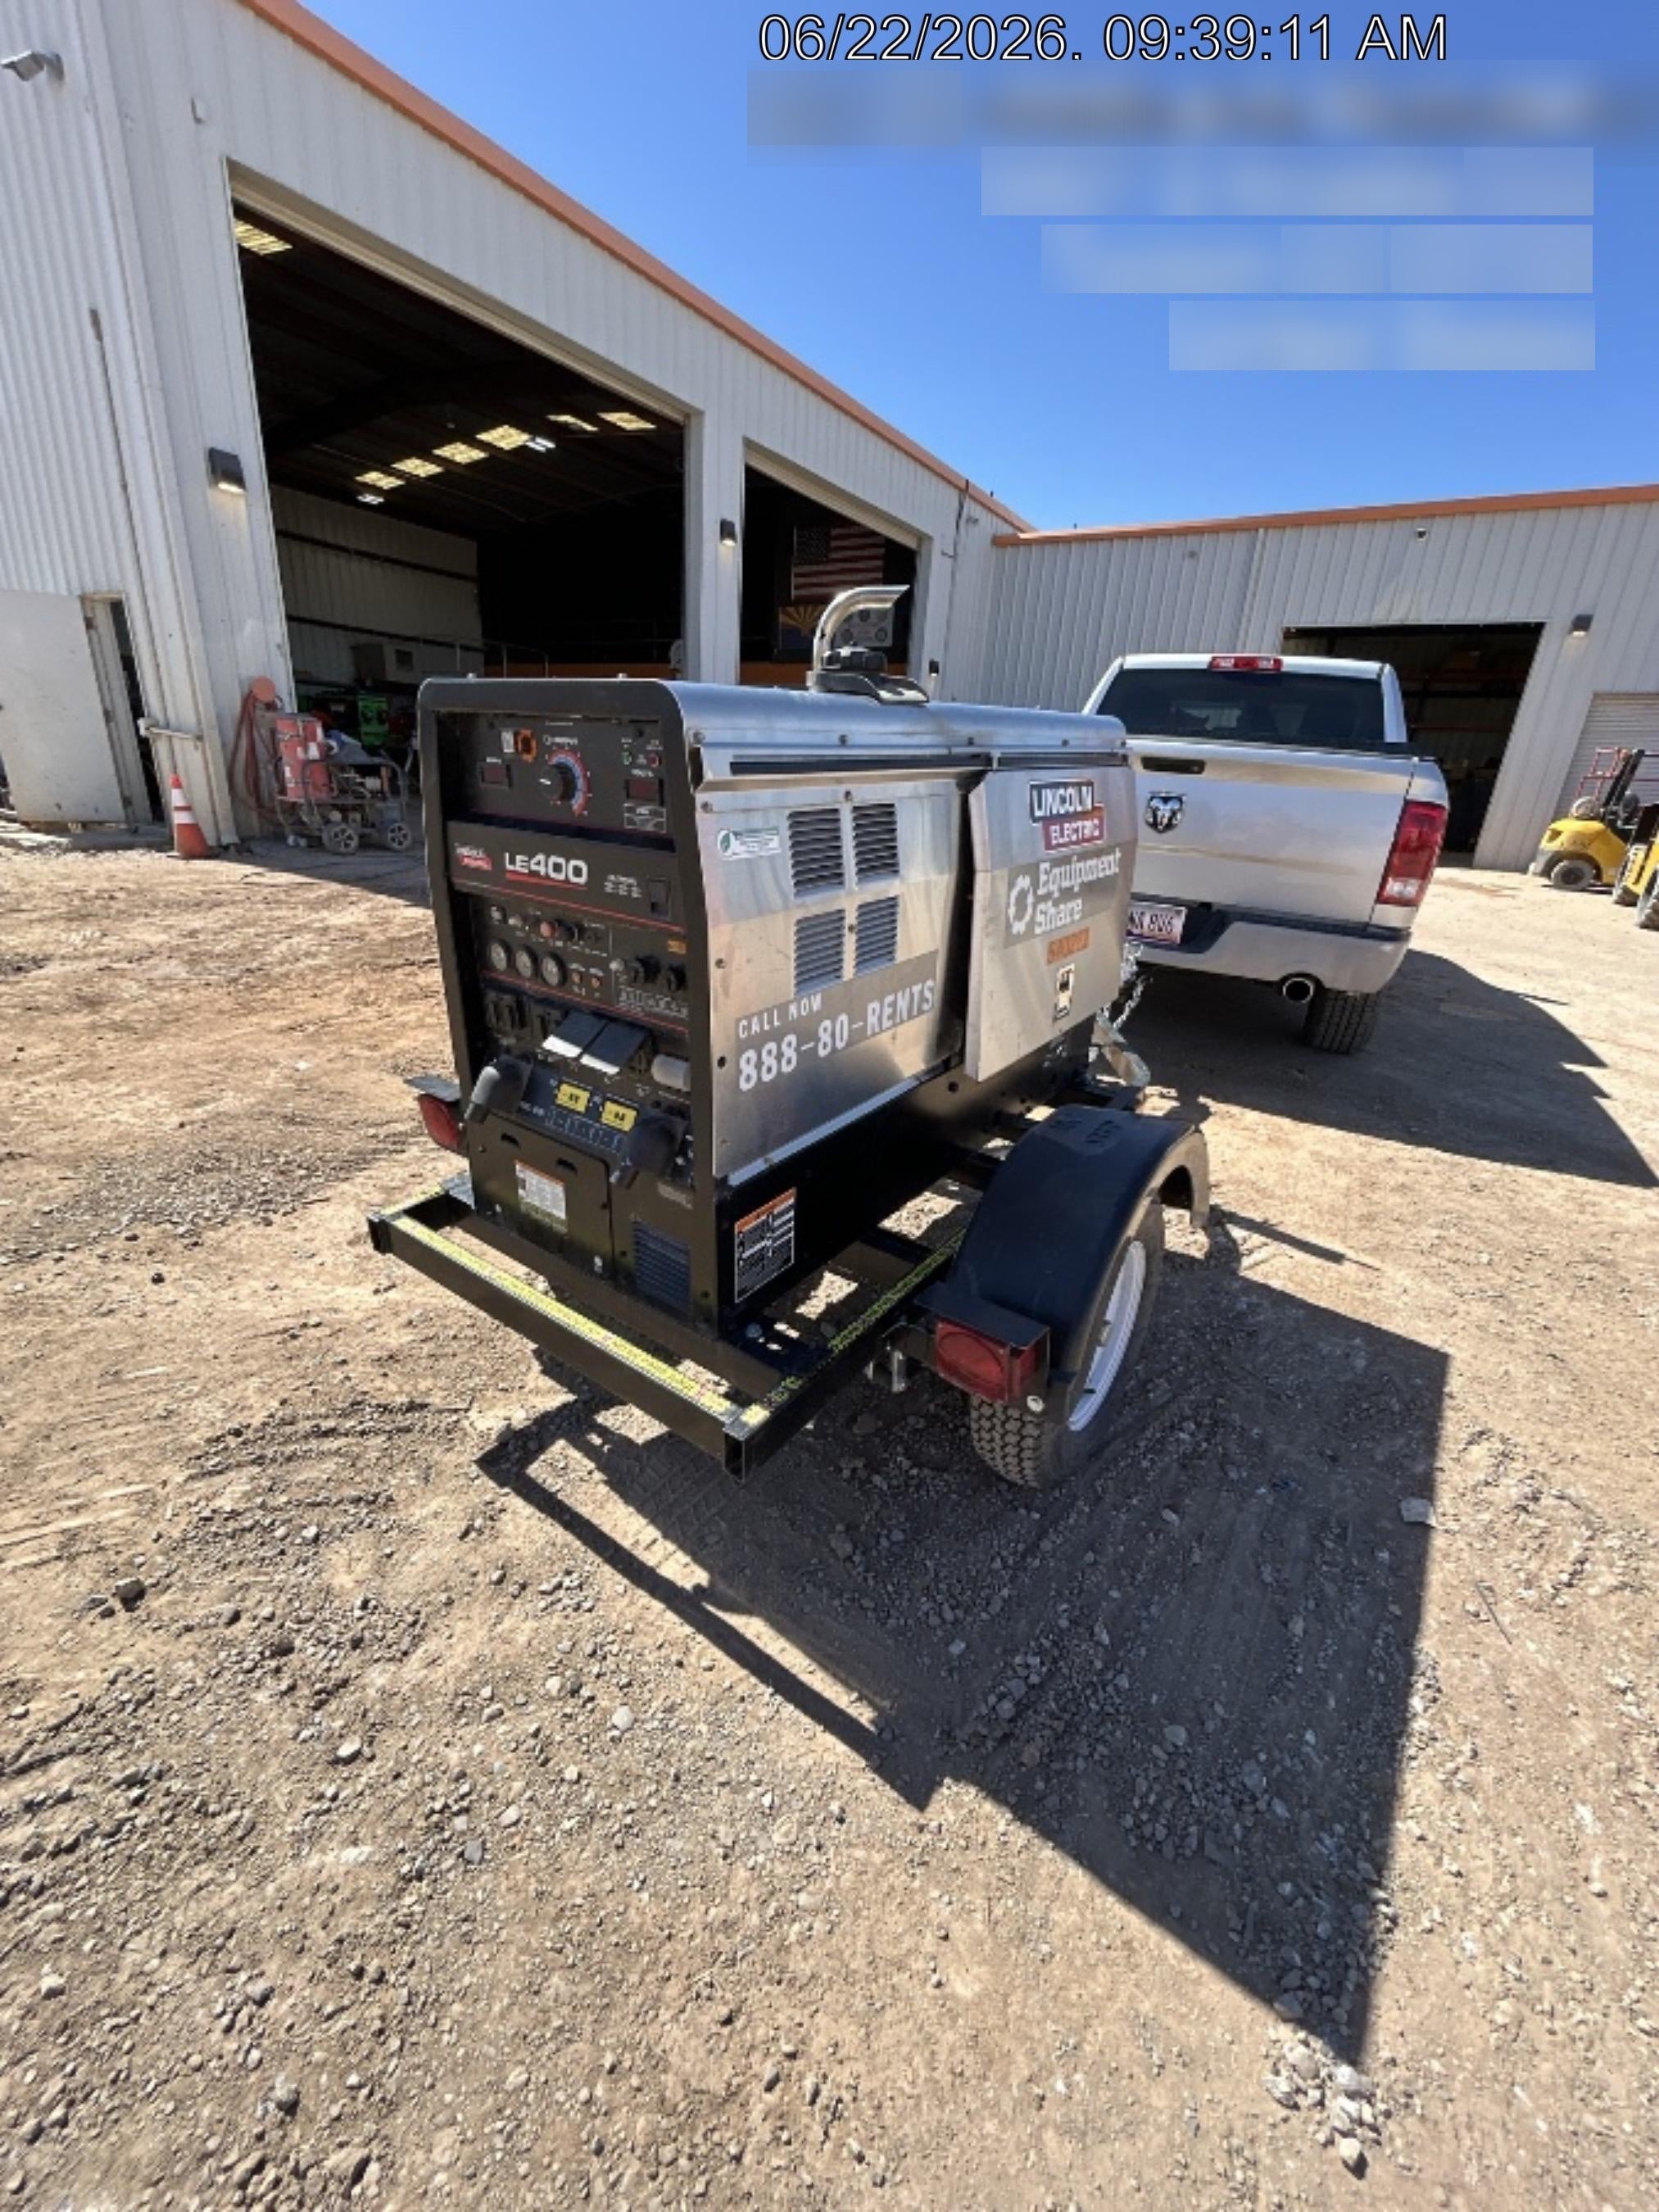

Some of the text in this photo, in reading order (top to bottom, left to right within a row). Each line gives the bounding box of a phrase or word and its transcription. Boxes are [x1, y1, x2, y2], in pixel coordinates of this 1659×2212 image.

[1032, 785, 1092, 818] LINCOLN
[1049, 818, 1099, 845] ELECTRIC
[504, 852, 589, 885] LE400
[1037, 848, 1122, 898] Equipment
[1034, 898, 1083, 935] Share
[739, 993, 823, 1038] CALL NOW
[739, 979, 935, 1091] 888-80-RENTS
